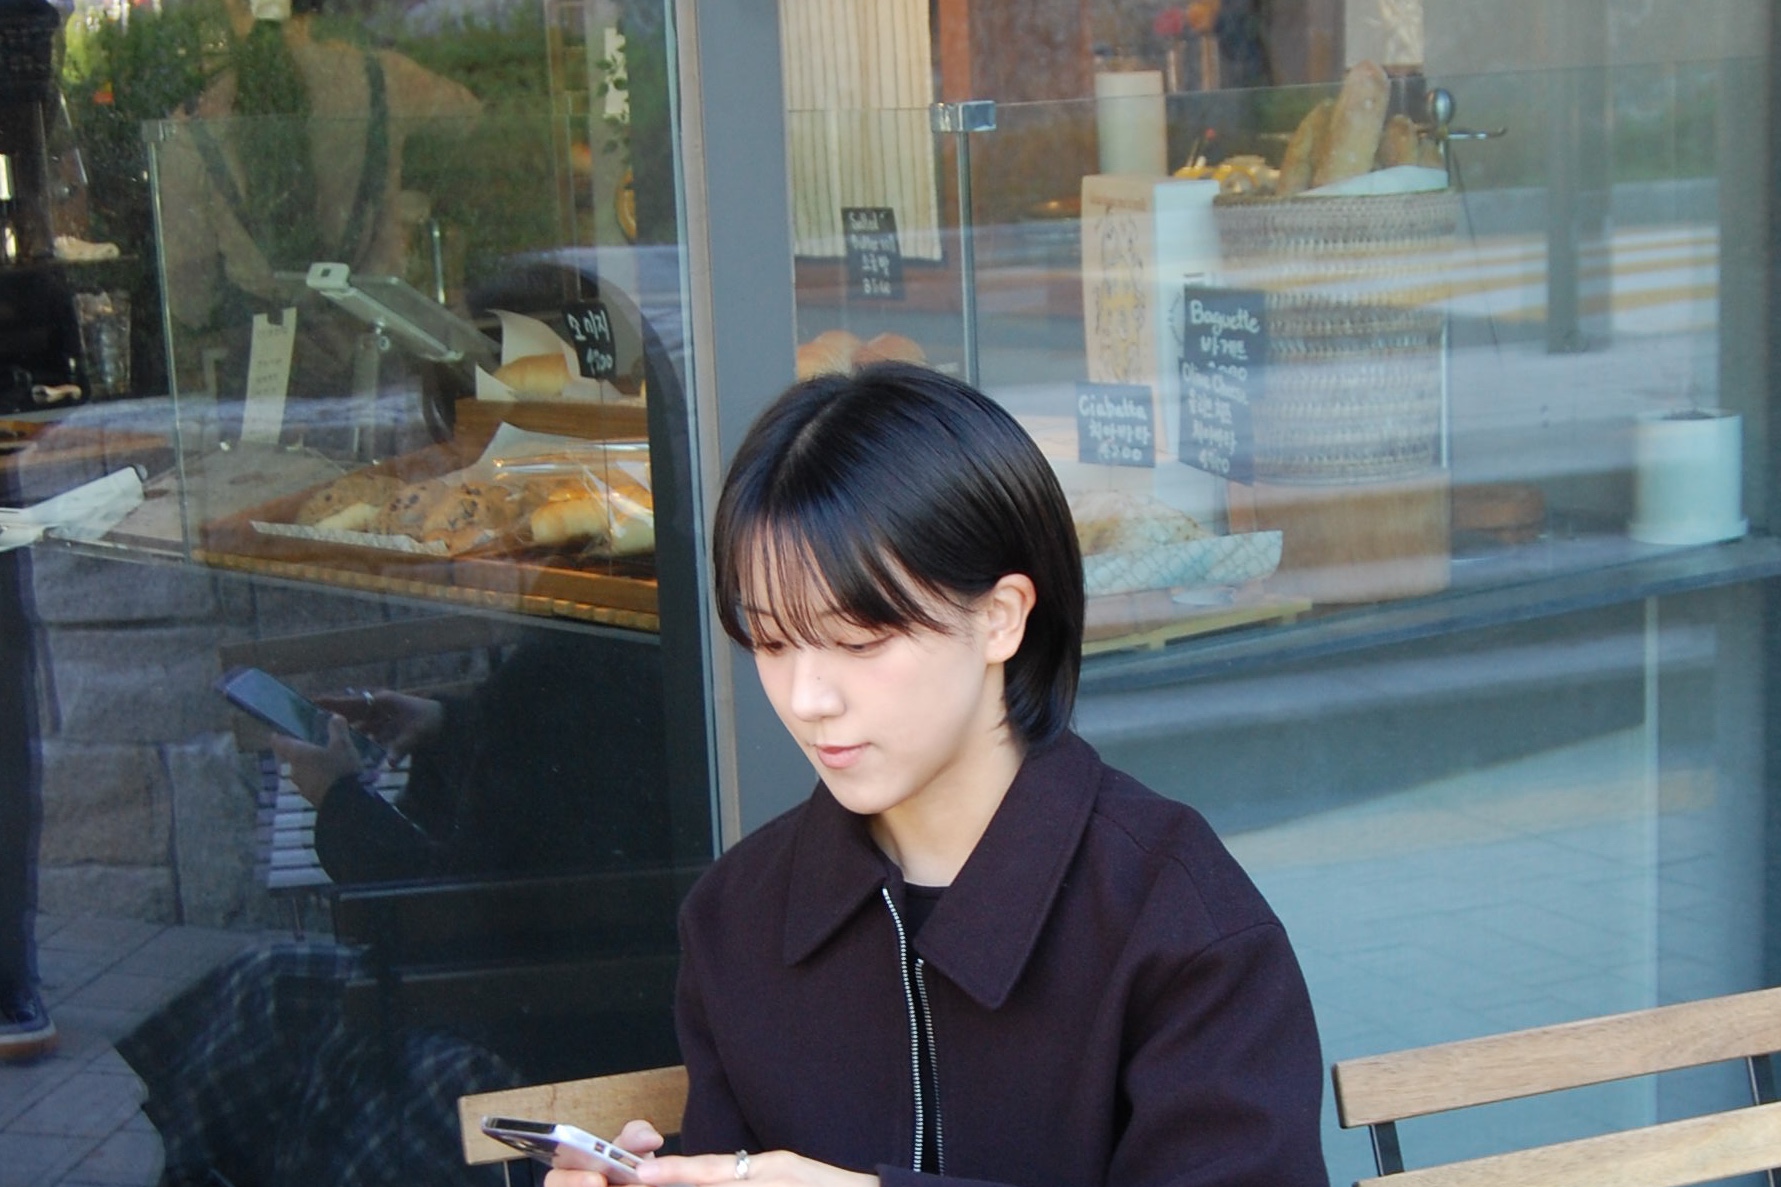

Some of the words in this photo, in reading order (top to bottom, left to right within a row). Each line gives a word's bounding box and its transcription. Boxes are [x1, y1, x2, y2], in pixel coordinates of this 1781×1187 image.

[1190, 298, 1260, 336] Baguette
[1201, 335, 1249, 360] 바게트
[1078, 393, 1148, 420] Ciabatta
